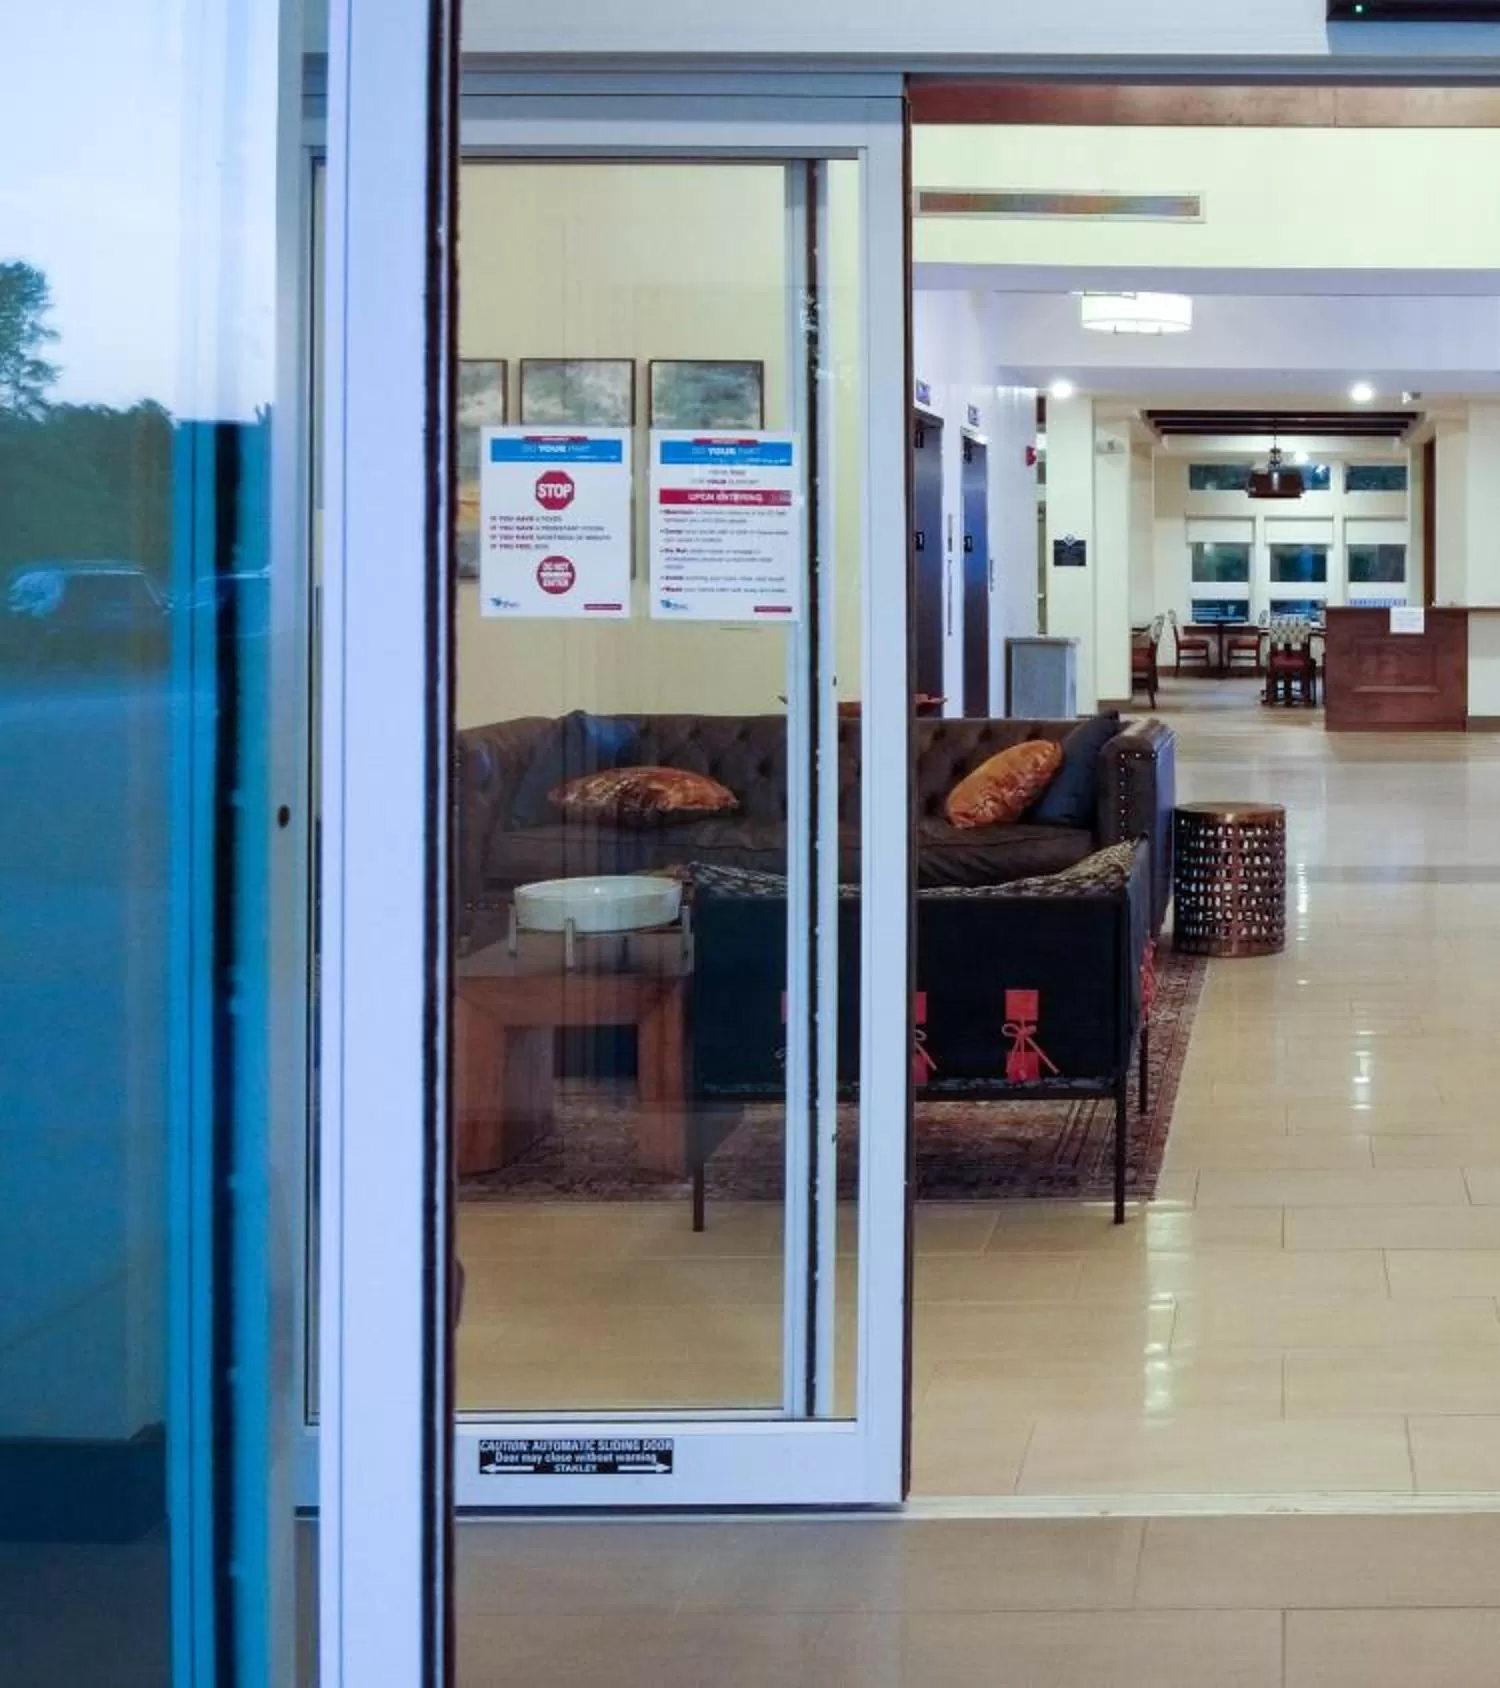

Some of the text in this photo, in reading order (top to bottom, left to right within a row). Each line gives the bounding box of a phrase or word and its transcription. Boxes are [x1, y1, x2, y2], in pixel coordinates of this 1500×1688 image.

[538, 483, 573, 498] STOP
[531, 1440, 597, 1452] AUTOMATIC
[598, 1440, 641, 1452] SLIDING
[643, 1440, 673, 1452] DOOR
[495, 1452, 657, 1464] Door may close without warning
[553, 1463, 598, 1473] STANLEY
